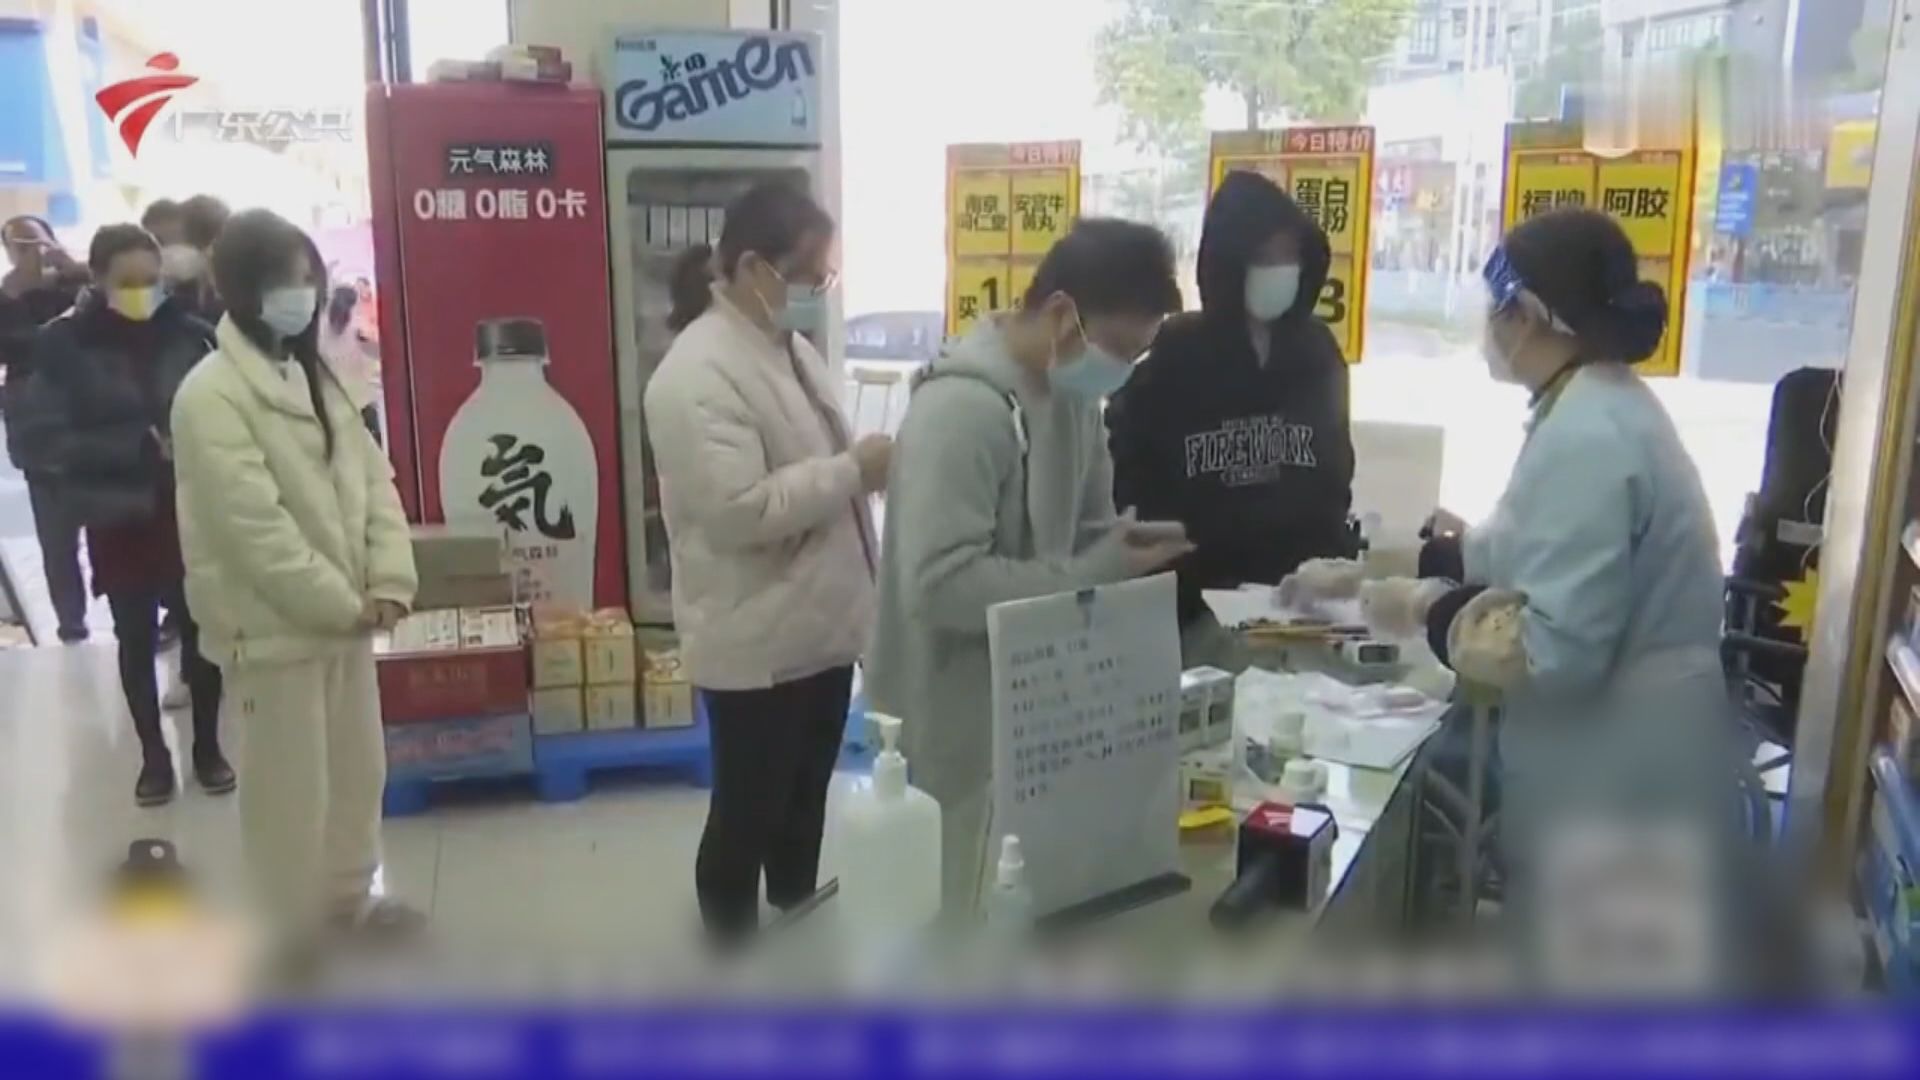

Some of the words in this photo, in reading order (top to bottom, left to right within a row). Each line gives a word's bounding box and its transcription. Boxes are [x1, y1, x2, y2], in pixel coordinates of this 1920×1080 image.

[615, 36, 815, 131] Ganten
[1290, 130, 1371, 151] 今日特价
[449, 147, 549, 174] 元气森林
[414, 188, 467, 220] 0糖
[475, 188, 529, 220] 0脂
[536, 188, 588, 220] 0卡
[1296, 178, 1349, 207] 蛋白
[1603, 188, 1669, 218] 阿胶
[1184, 423, 1317, 478] FIREWORK
